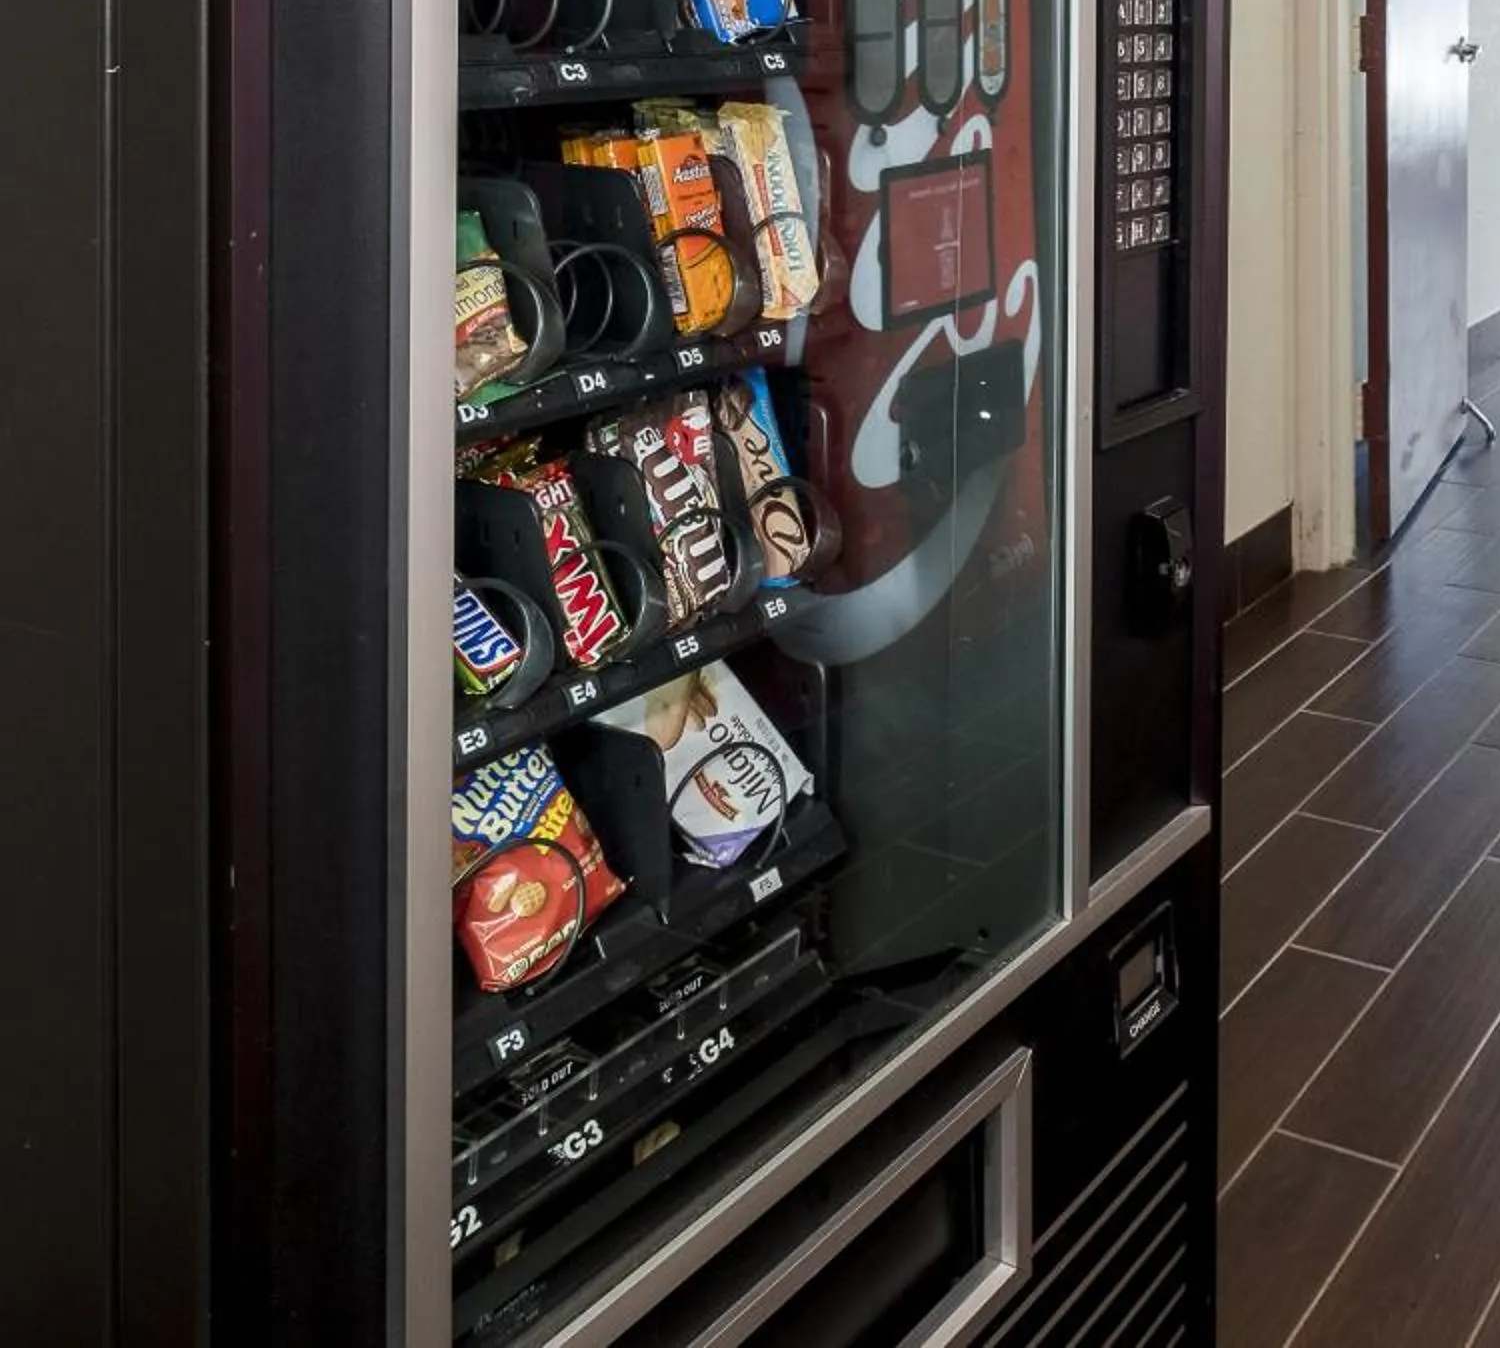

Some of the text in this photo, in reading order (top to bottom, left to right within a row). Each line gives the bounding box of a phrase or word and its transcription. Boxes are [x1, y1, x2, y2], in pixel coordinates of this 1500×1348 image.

[560, 61, 588, 82] C3
[763, 53, 786, 71] C5
[759, 330, 783, 348] D6
[678, 349, 704, 368] D5
[578, 372, 607, 394] D4
[458, 405, 489, 423] D3
[544, 513, 621, 666] TWIX
[764, 598, 788, 619] E6
[675, 635, 700, 658] E5
[568, 680, 598, 706] E4
[457, 727, 488, 755] E3
[451, 748, 530, 835] Nutte
[478, 746, 554, 843] Butter
[683, 975, 703, 996] OUT
[1129, 1000, 1161, 1038] CHANGE
[495, 1028, 526, 1060] F3
[699, 1026, 735, 1064] G4
[551, 1062, 574, 1086] OUT
[563, 1118, 604, 1161] G3
